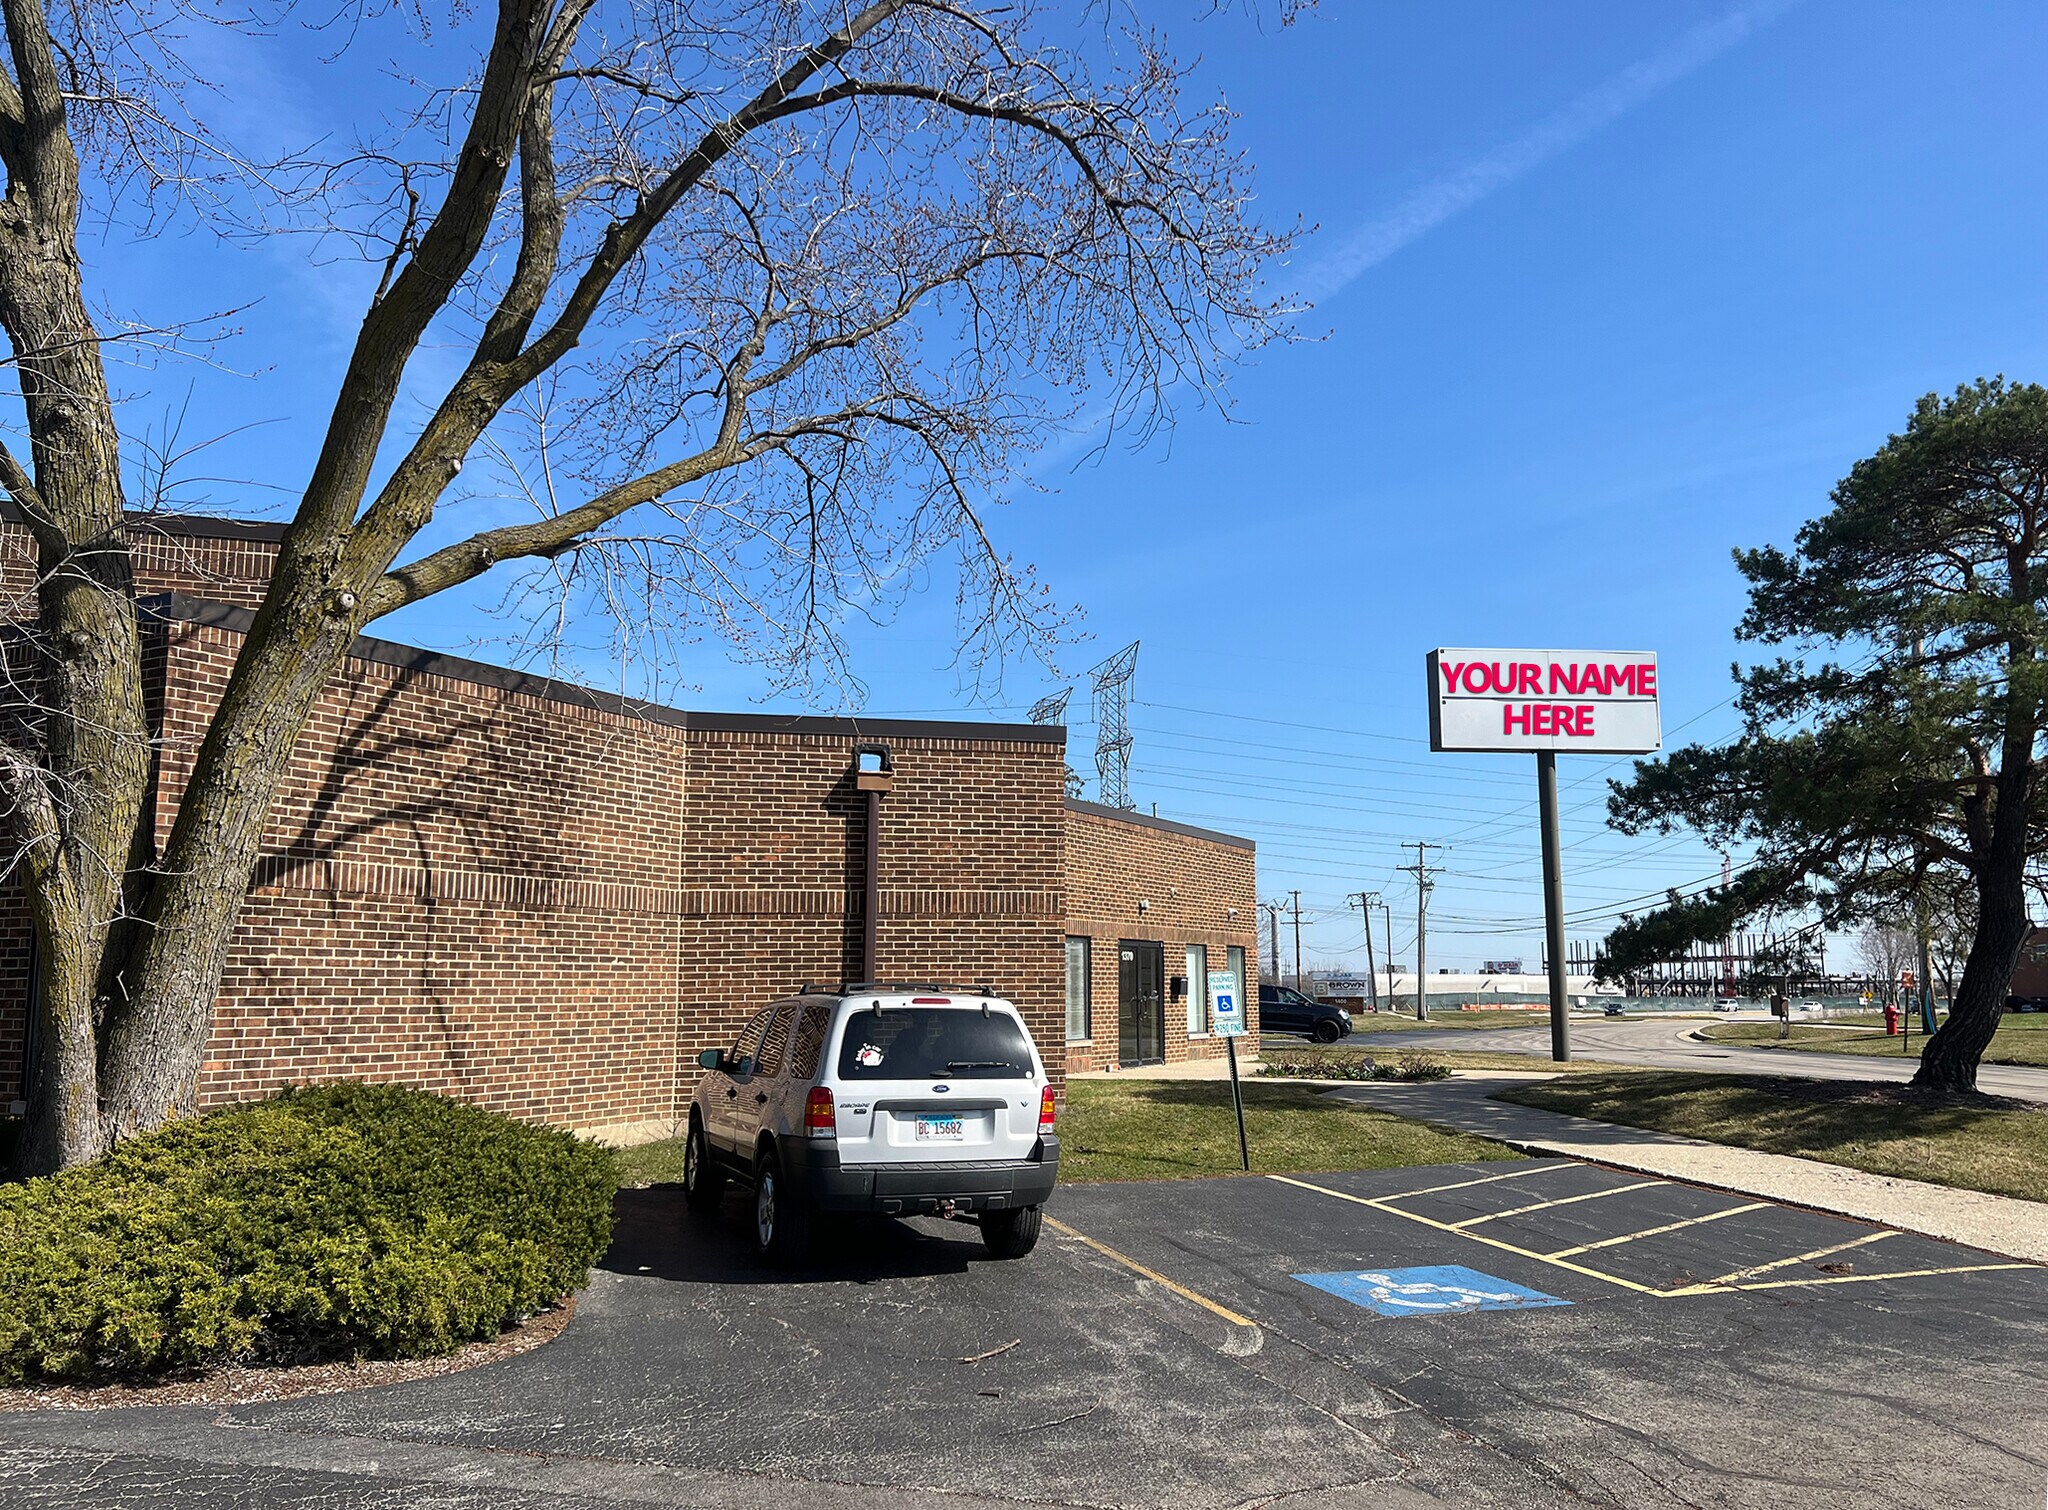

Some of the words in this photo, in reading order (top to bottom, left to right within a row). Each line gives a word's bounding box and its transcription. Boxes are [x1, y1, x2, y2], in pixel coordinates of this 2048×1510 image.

[1440, 662, 1543, 694] YOUR
[1550, 663, 1656, 695] NAME
[1504, 704, 1595, 737] HERE
[1209, 975, 1236, 983] RESERVED
[1328, 981, 1365, 989] BROWN
[1212, 983, 1234, 991] PARKING
[1215, 1023, 1229, 1034] $250
[1230, 1022, 1242, 1033] FINE
[918, 1121, 930, 1135] BC
[934, 1121, 962, 1135] 15682
